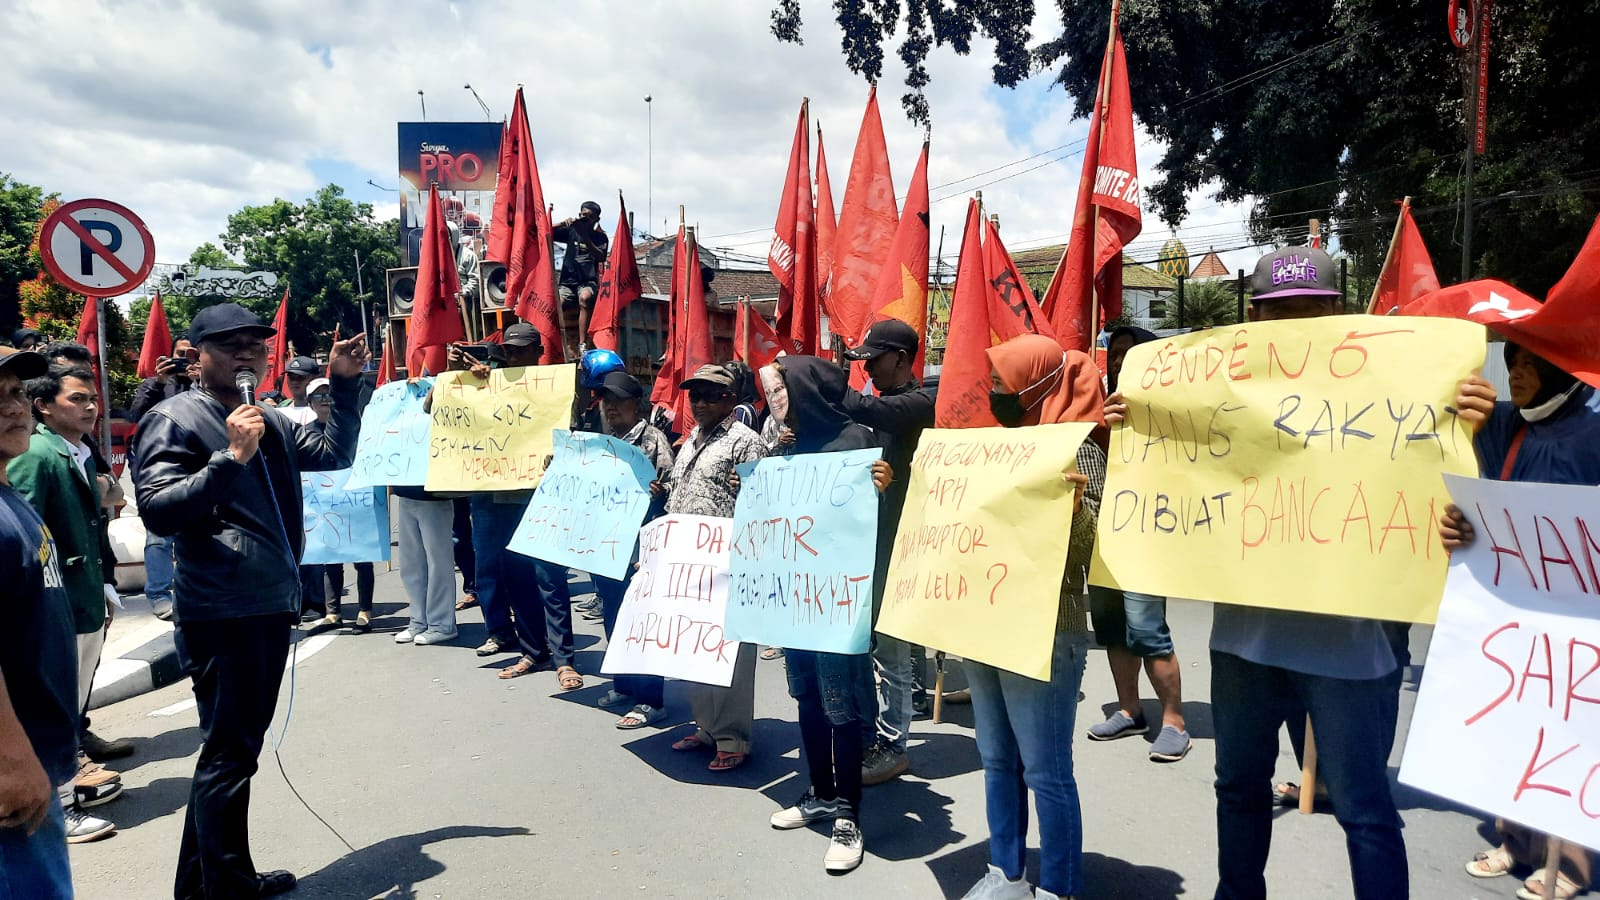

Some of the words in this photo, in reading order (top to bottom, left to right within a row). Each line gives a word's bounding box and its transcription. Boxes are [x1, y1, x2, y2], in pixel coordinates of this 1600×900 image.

[419, 152, 483, 183] PRO
[492, 404, 532, 427] KOK
[1118, 401, 1248, 464] UANG
[1273, 394, 1460, 462] RAKYAT
[462, 454, 545, 481] MERAJALEL
[922, 476, 968, 512] APH
[1112, 488, 1232, 537] DIBUAT
[696, 522, 731, 554] DA
[793, 571, 870, 627] RAKYAT
